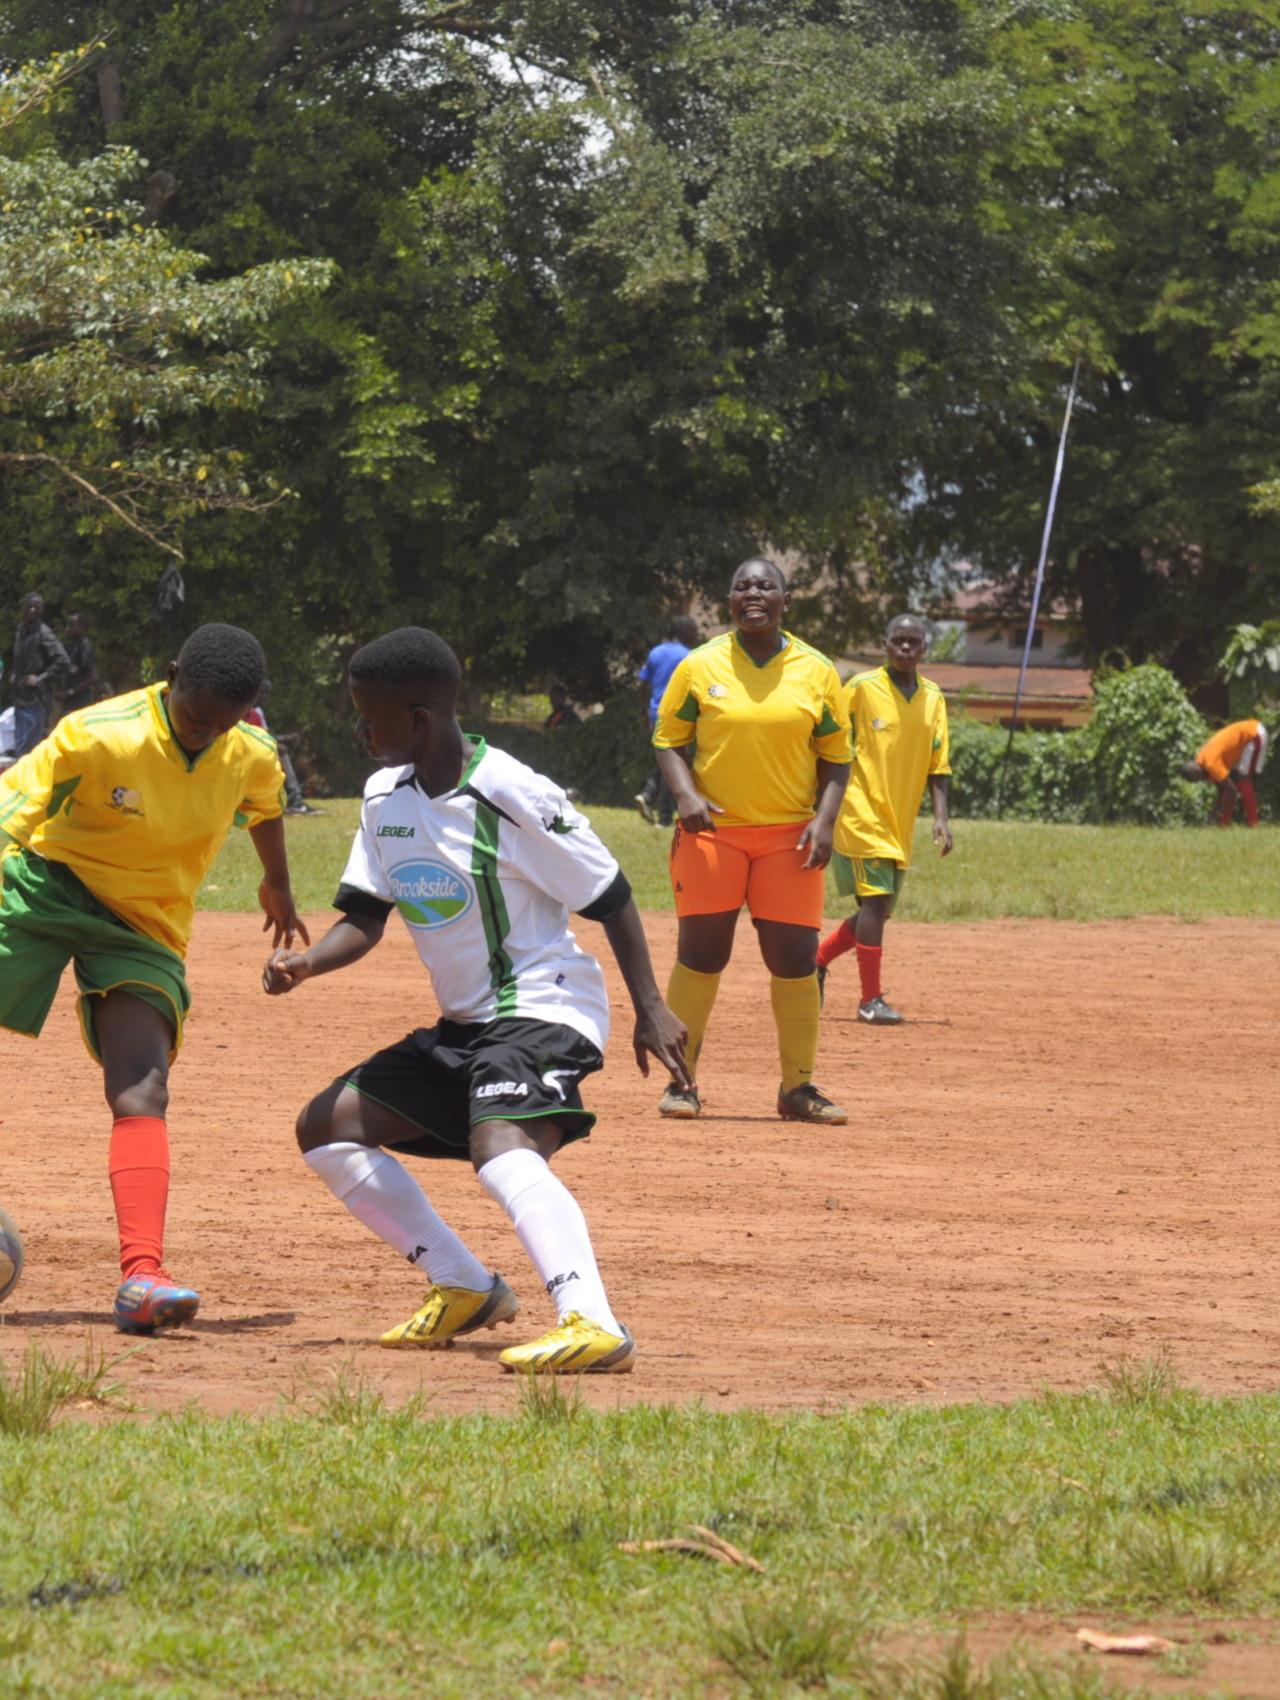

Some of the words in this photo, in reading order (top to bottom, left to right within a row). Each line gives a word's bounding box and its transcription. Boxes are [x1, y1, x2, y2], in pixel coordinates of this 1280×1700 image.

[376, 825, 415, 838] LEGEA
[390, 876, 459, 898] Brookside
[475, 1081, 528, 1099] LEGEA
